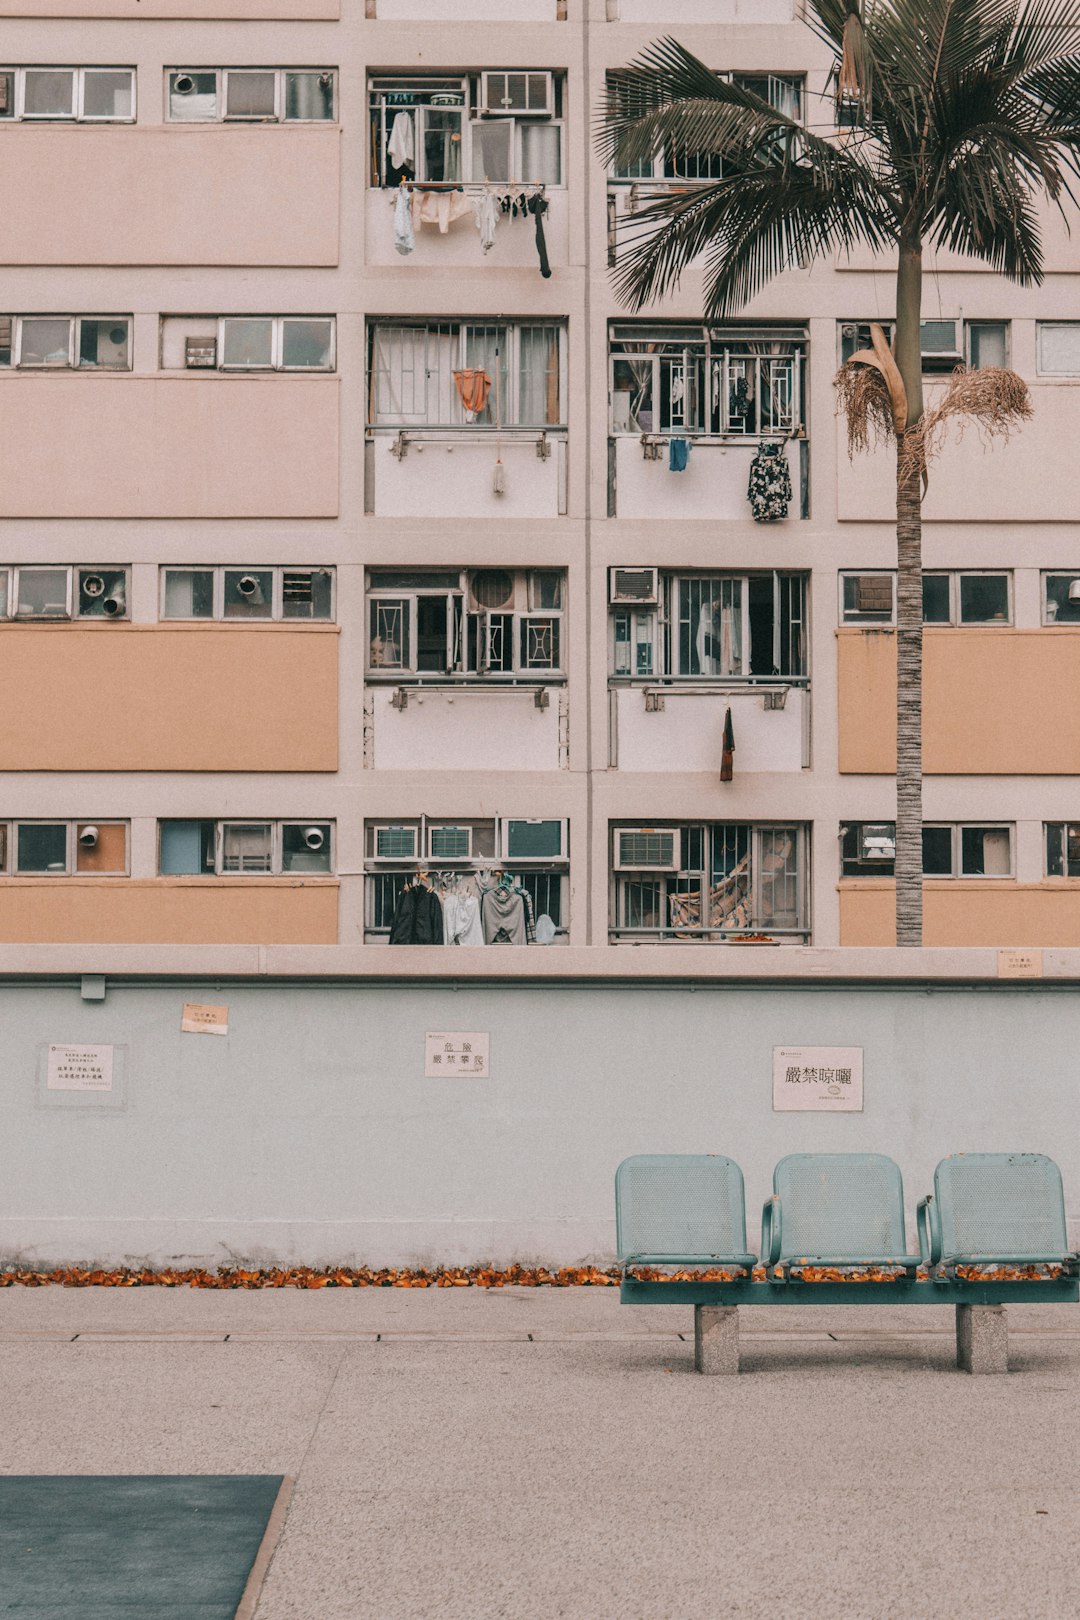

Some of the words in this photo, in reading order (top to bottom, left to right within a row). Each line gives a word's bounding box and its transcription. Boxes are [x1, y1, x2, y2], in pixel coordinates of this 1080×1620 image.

[444, 1042, 472, 1052] 危險
[433, 1054, 484, 1065] 嚴禁攀爬
[785, 1066, 852, 1085] 嚴禁晾曬
